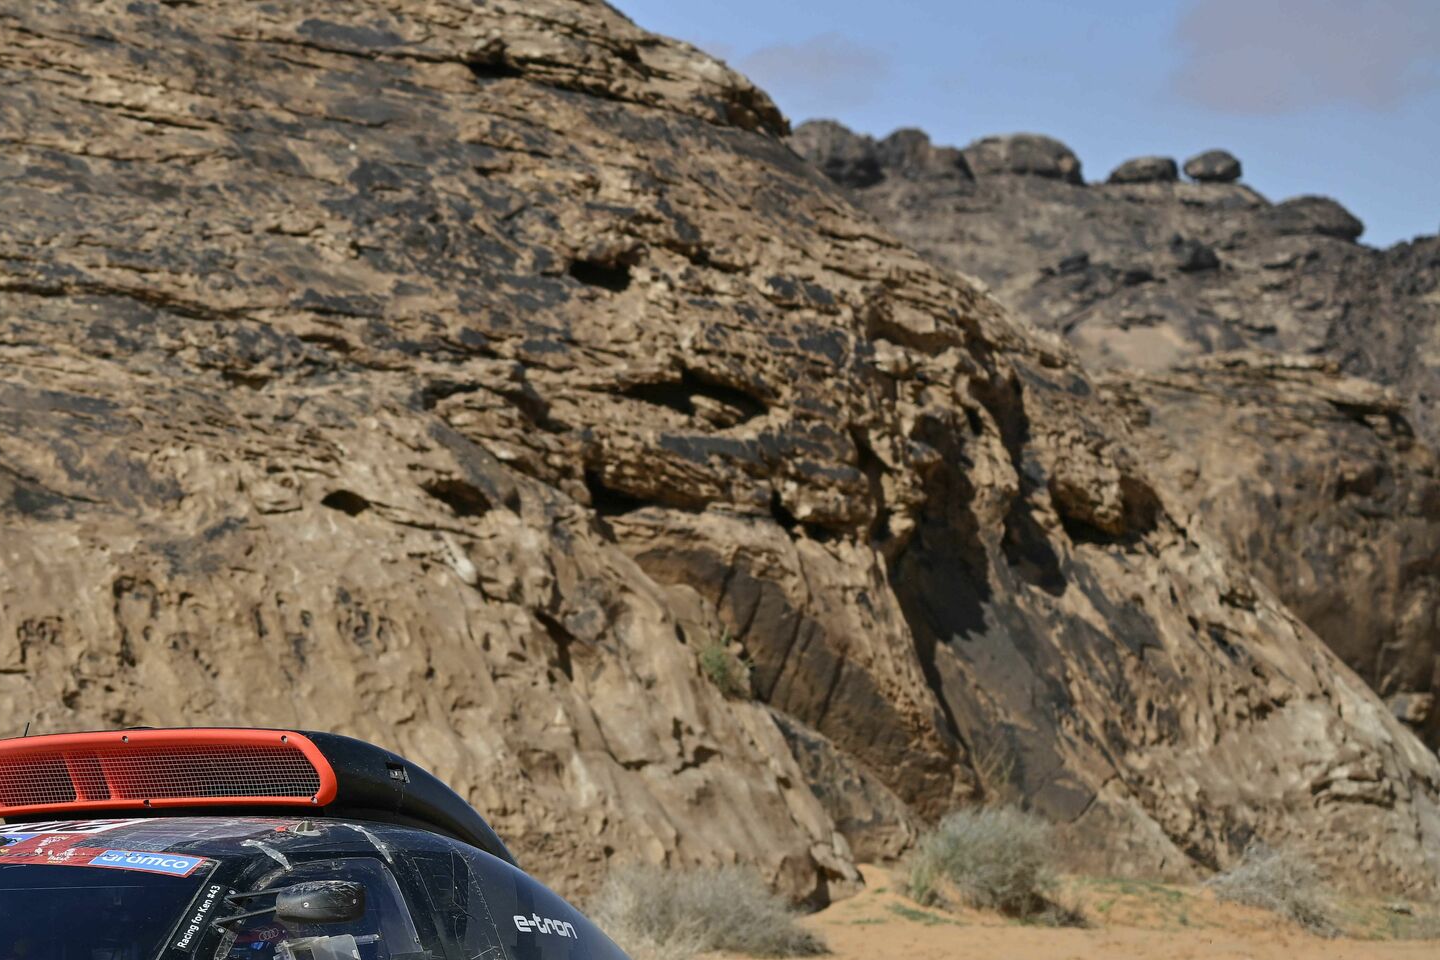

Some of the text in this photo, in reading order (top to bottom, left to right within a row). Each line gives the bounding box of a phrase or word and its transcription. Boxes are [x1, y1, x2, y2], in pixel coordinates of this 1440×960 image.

[103, 853, 190, 869] aramco
[197, 899, 213, 914] Ken
[191, 912, 204, 925] for
[513, 912, 578, 939] e-tron
[177, 924, 200, 949] Racing
